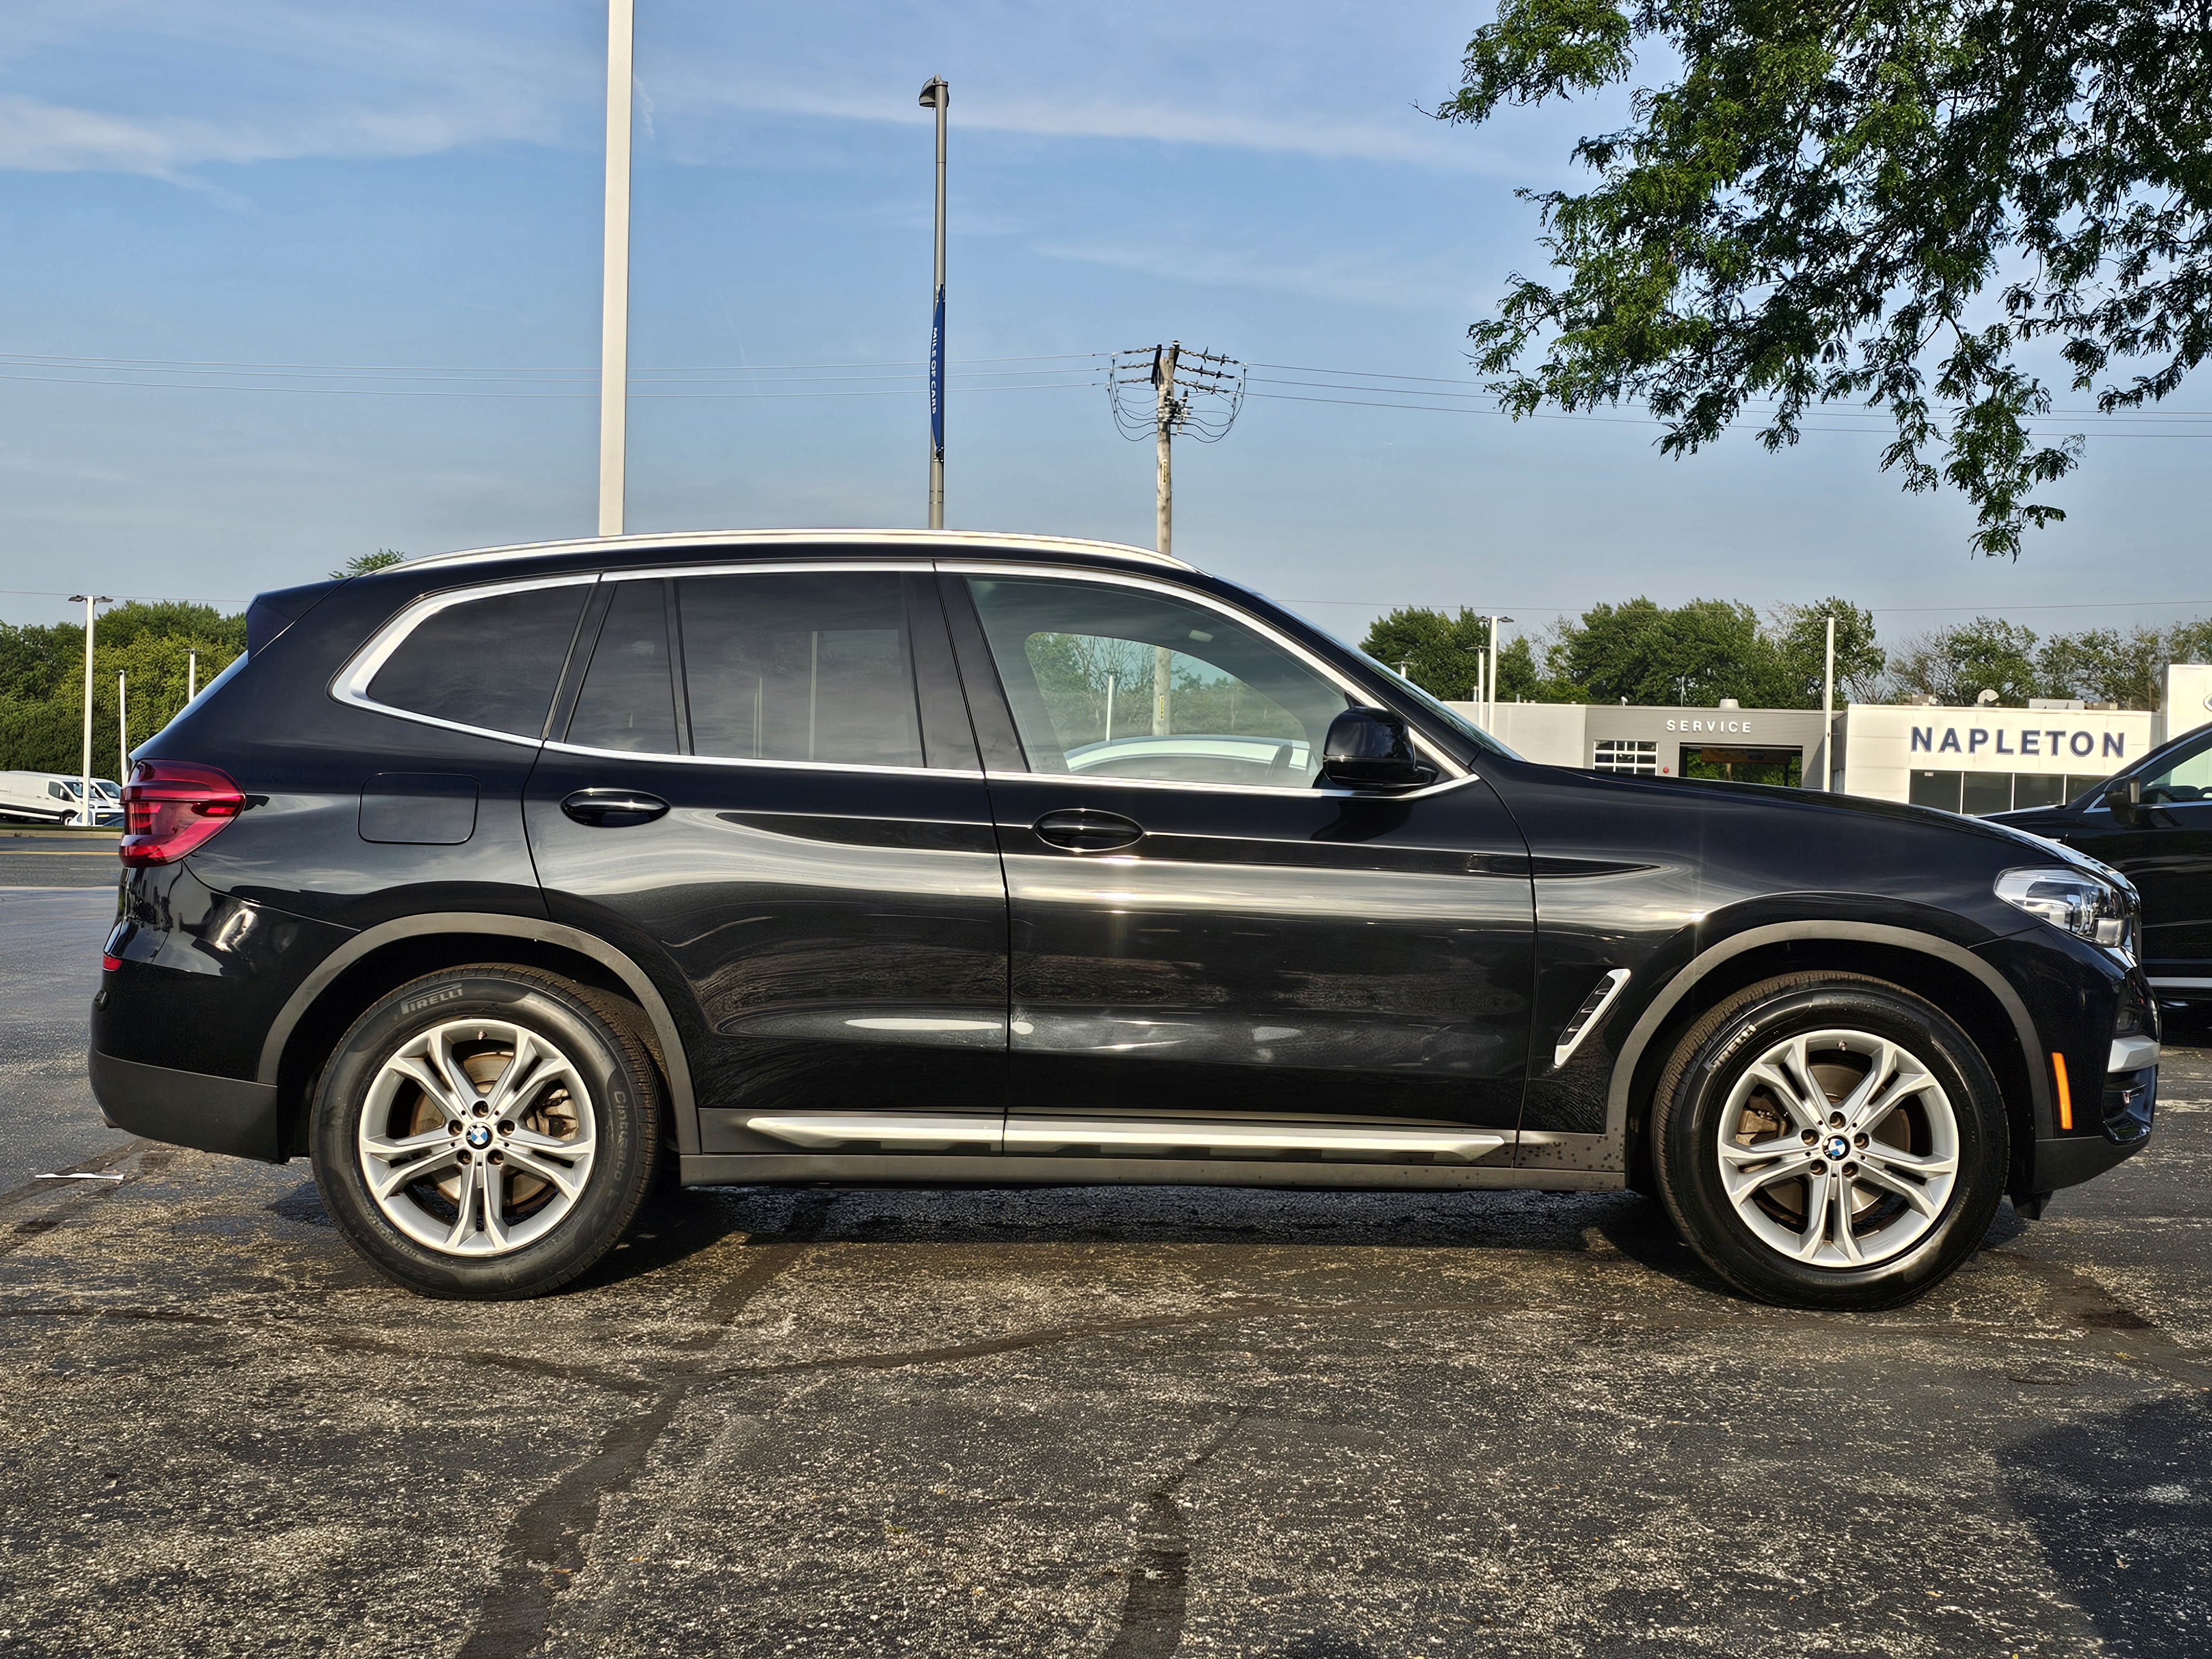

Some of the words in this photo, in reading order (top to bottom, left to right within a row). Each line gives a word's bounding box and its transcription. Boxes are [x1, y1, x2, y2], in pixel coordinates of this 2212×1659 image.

[931, 360, 936, 377] OF
[1666, 719, 1751, 733] SERVICE
[1911, 726, 2125, 758] NAPLETON
[400, 983, 462, 1014] PIRELLI
[1703, 1020, 1756, 1074] PIRELLI
